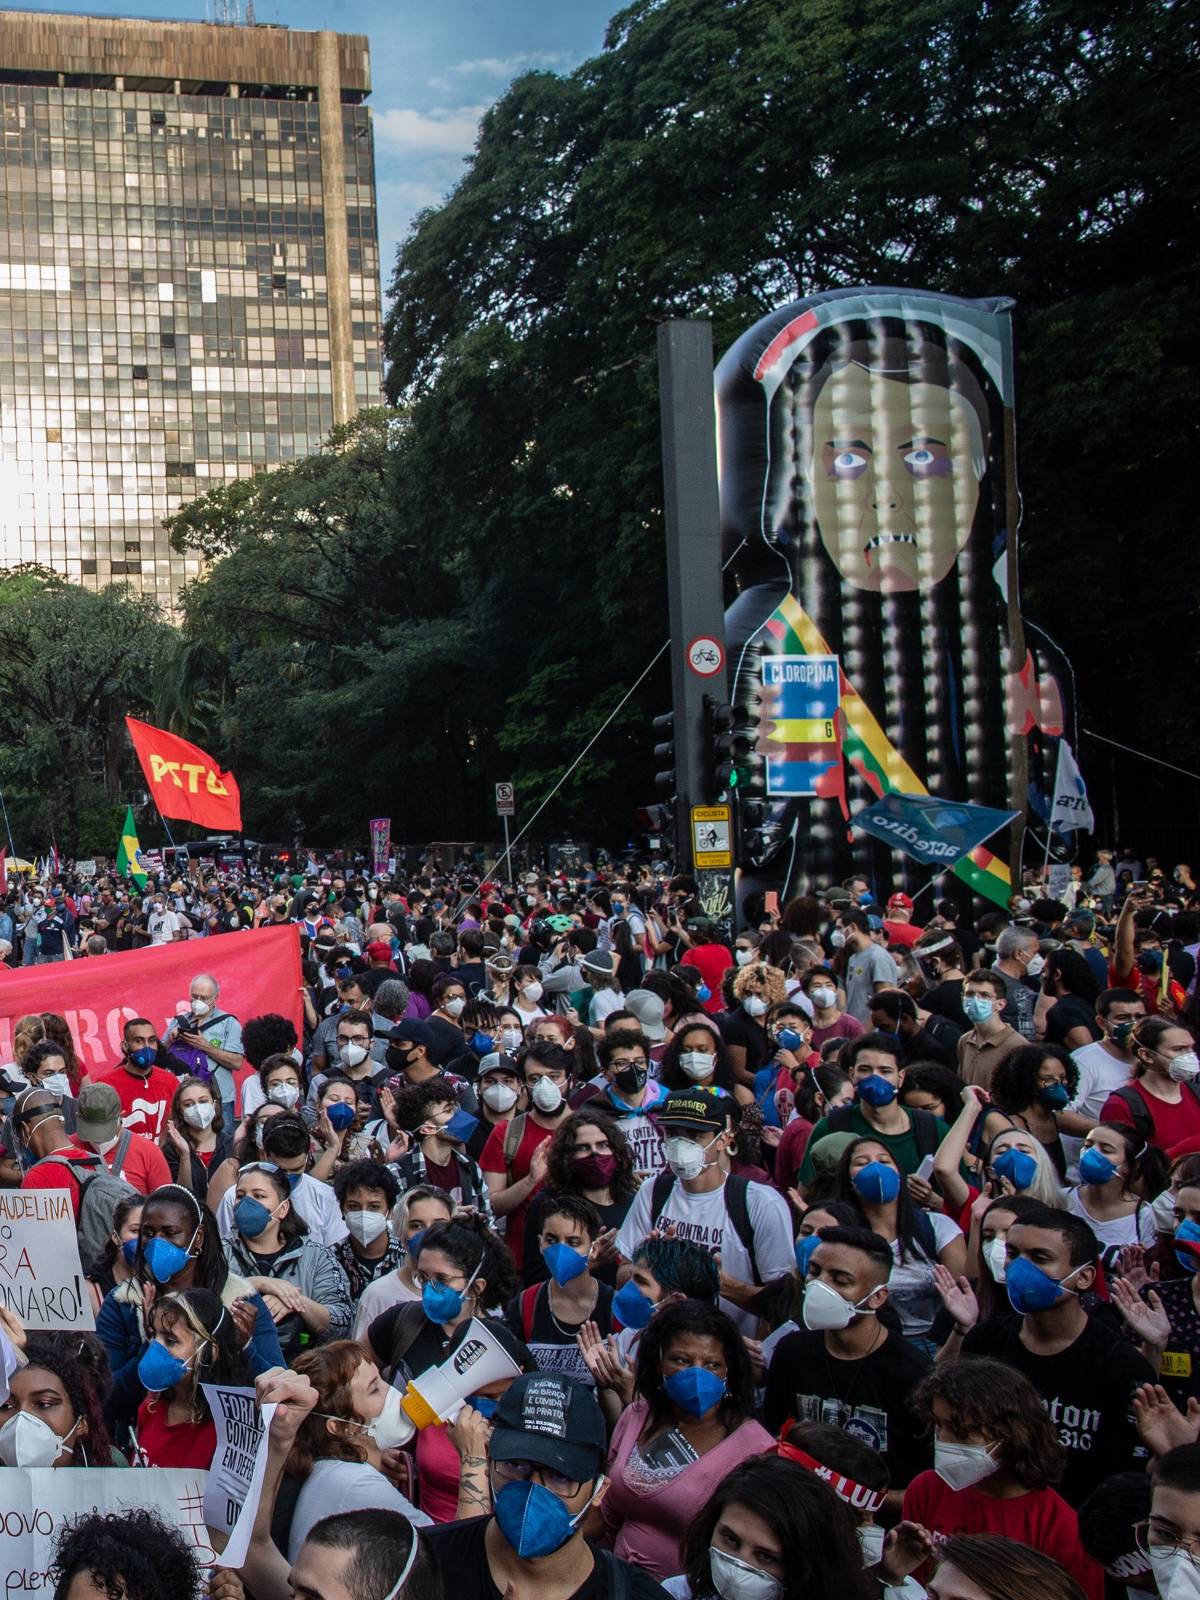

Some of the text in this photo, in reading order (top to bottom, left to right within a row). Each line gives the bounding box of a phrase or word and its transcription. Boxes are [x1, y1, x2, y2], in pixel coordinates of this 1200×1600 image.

[771, 665, 834, 682] CLOROPINA
[825, 721, 833, 738] G
[634, 1137, 666, 1170] RTES
[676, 1221, 724, 1245] CONTRA OS
[457, 1341, 477, 1364] FORA
[534, 1381, 561, 1390] VACINA
[540, 1388, 566, 1400] BRAÇO
[528, 1396, 534, 1404] E
[218, 1392, 255, 1428] FORA
[524, 1406, 536, 1415] NO
[222, 1446, 256, 1482] EM DEFES
